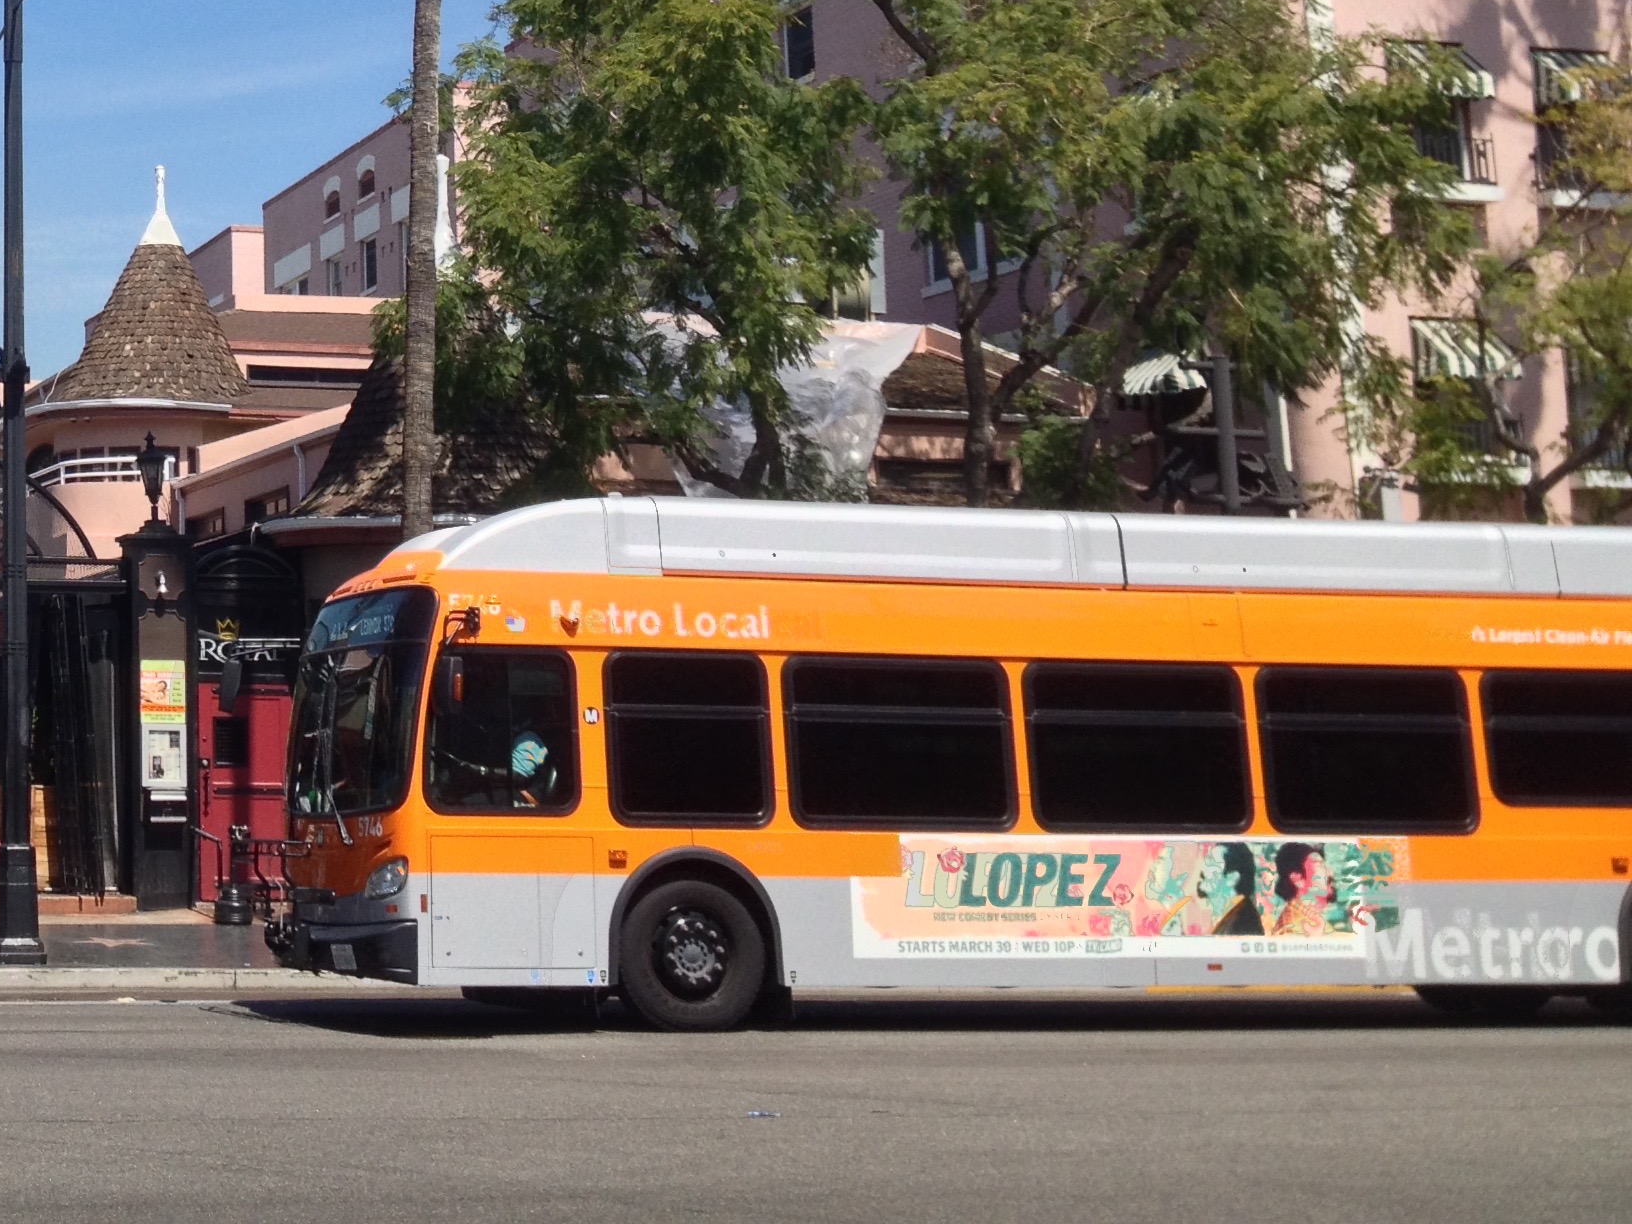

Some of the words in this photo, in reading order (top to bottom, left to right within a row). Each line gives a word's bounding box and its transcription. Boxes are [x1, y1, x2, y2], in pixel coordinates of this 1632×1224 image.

[549, 598, 661, 638] Metro
[673, 602, 769, 639] Local
[898, 940, 946, 954] STARTS
[949, 940, 994, 954] MARCH
[1022, 940, 1050, 954] WED
